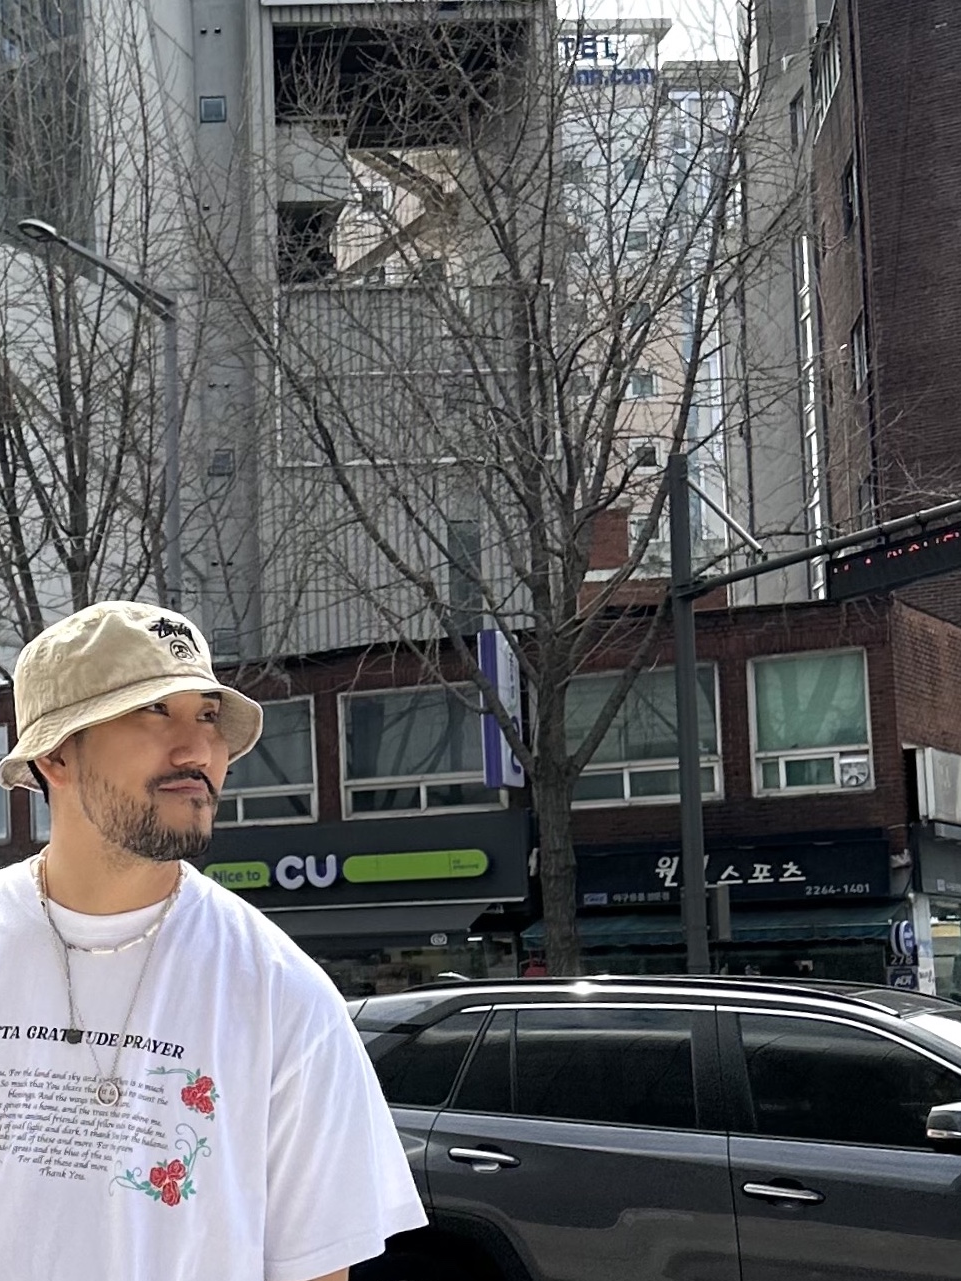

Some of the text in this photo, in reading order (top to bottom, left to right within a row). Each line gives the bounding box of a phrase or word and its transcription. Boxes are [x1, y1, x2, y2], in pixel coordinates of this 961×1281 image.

[212, 854, 337, 890] Nice to CU
[655, 855, 807, 889] 원스포츠
[805, 883, 871, 896] 2264-1401
[26, 1025, 120, 1048] GRATTUDE
[122, 1034, 185, 1060] PRAYER
[52, 1070, 68, 1080] and
[82, 1073, 97, 1082] and
[61, 1106, 78, 1114] and
[80, 1116, 96, 1126] and
[45, 1122, 61, 1133] and
[57, 1135, 74, 1145] and
[33, 1144, 50, 1154] and
[73, 1159, 90, 1169] and
[39, 1165, 67, 1178] Thank
